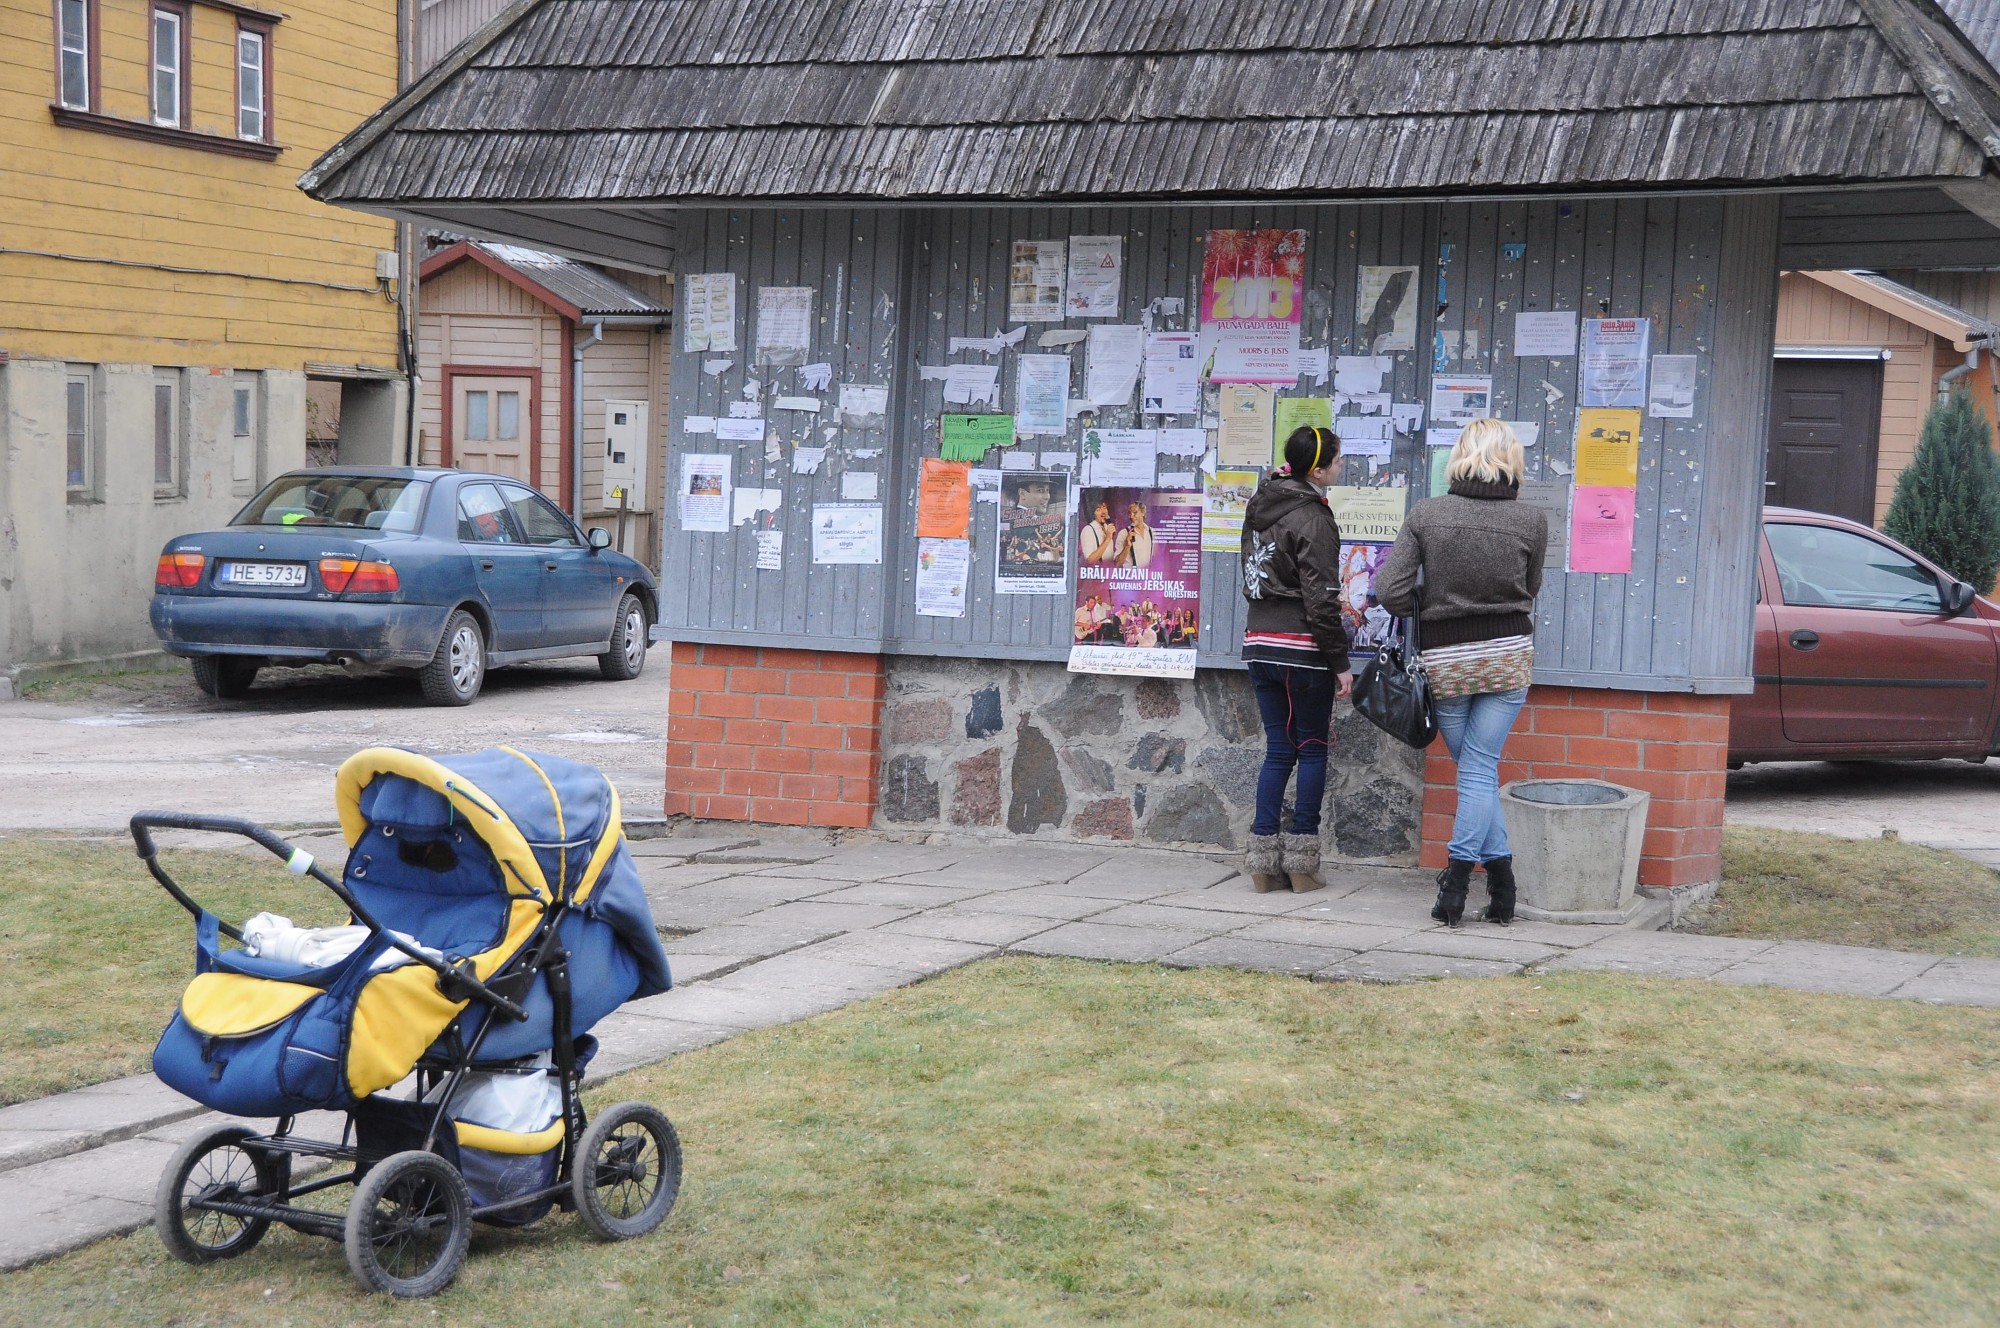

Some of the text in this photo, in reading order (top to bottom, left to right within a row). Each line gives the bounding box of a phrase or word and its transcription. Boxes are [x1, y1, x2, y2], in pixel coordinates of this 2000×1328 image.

[1212, 277, 1293, 319] 2013
[1243, 321, 1265, 330] GADA
[1267, 321, 1290, 330] BALLE
[1271, 347, 1289, 355] JUSTS
[1366, 512, 1402, 521] SVĒTKU
[1338, 524, 1398, 536] ATLAIDES
[1080, 565, 1109, 582] BRĀĻI
[1111, 566, 1148, 580] AUZĀNI
[1151, 571, 1163, 580] UN
[1109, 582, 1142, 590] SLAVENAIS
